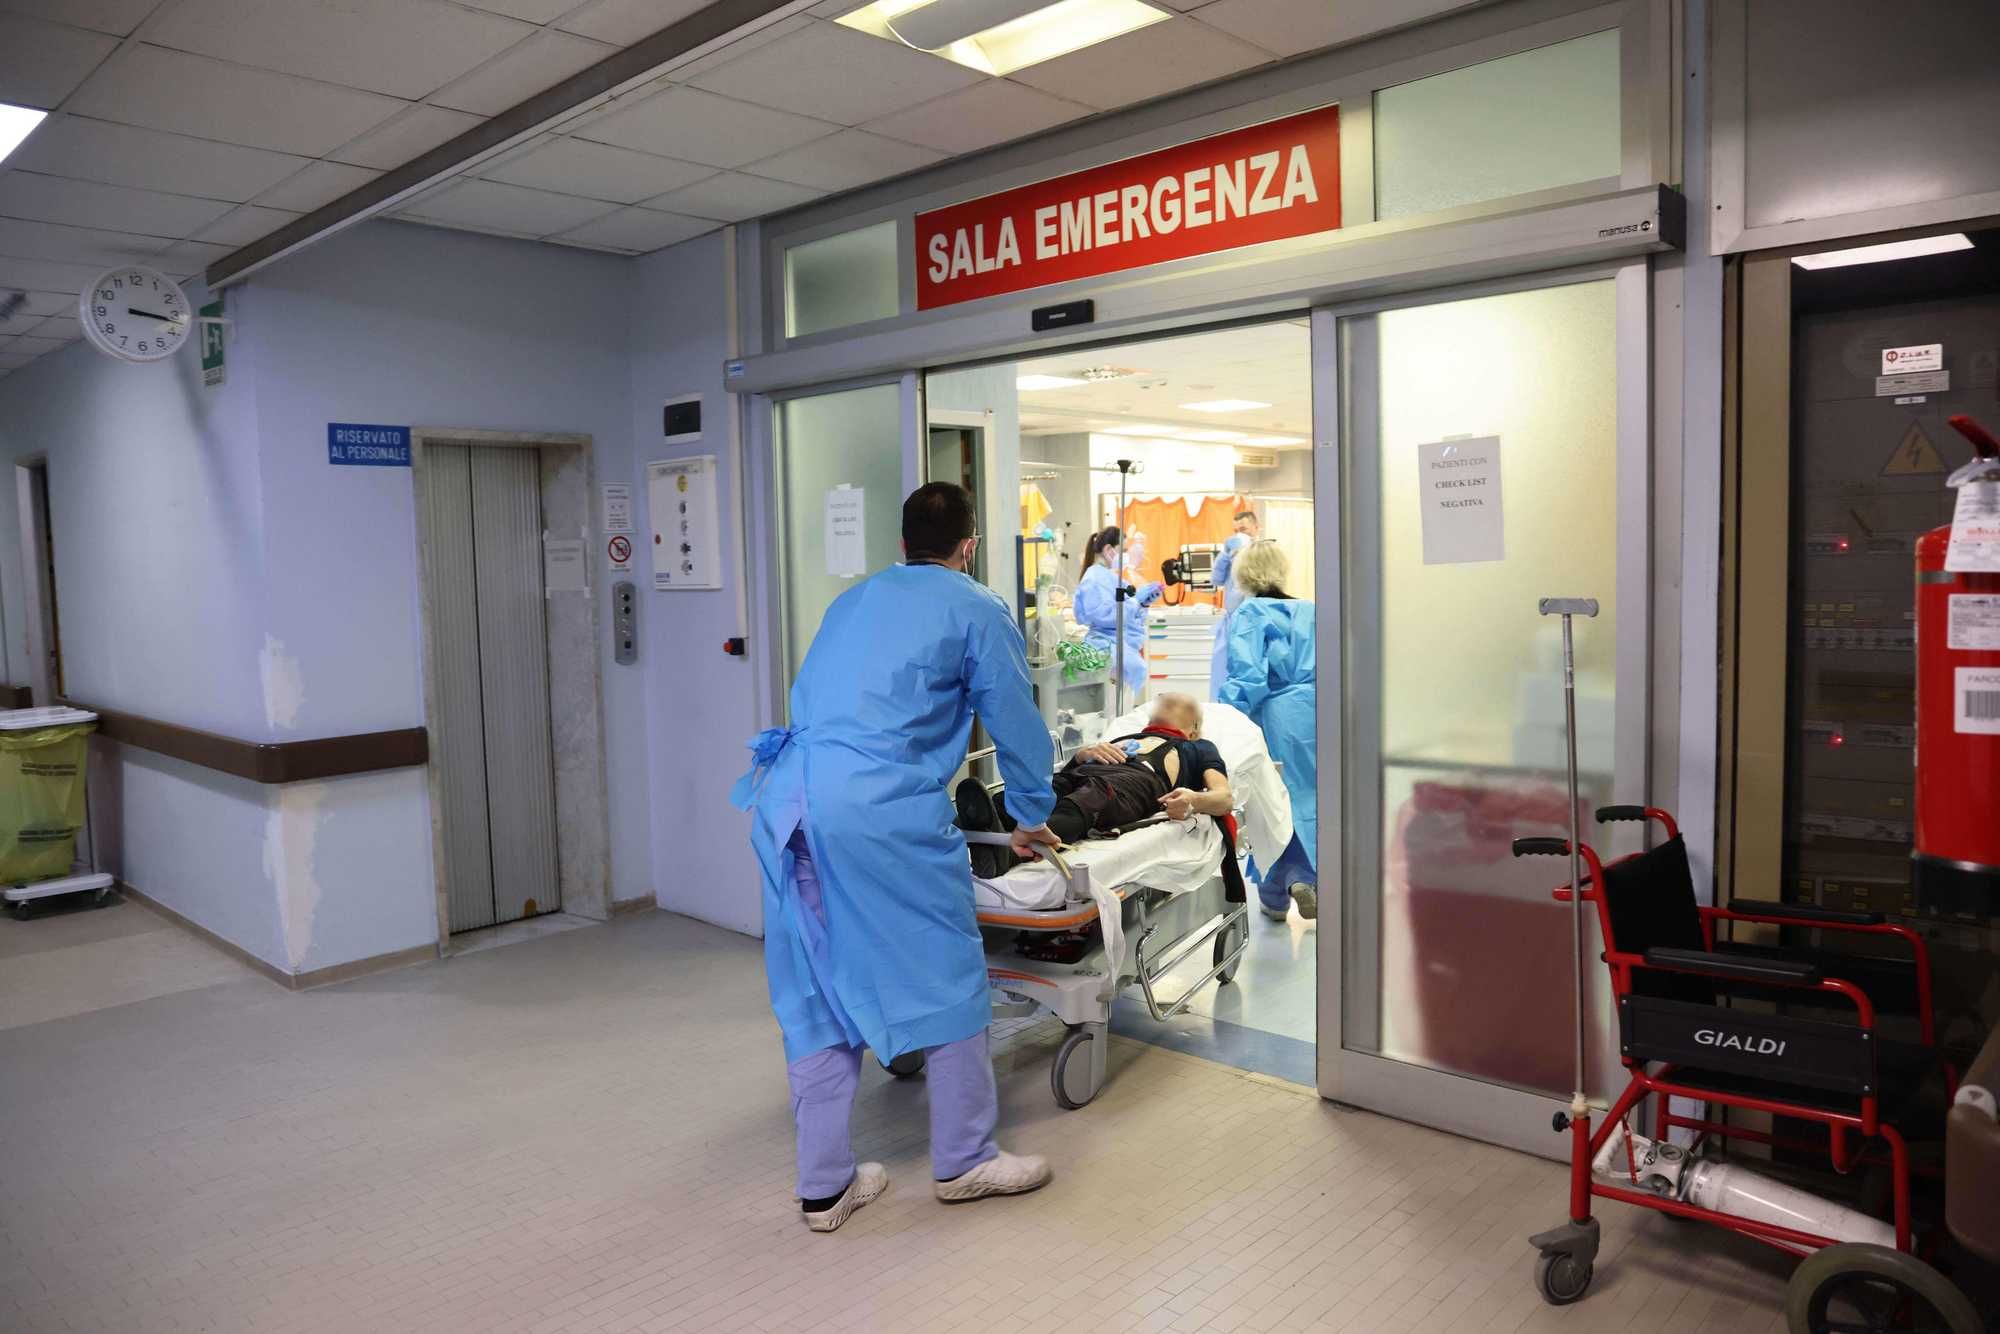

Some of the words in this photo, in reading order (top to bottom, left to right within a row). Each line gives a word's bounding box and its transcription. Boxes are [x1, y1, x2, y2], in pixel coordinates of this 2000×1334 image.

[928, 216, 1021, 283] SALA
[1035, 144, 1319, 261] EMERGENZA
[1599, 225, 1638, 237] manusa
[113, 279, 123, 288] 11
[129, 275, 143, 286] 12
[153, 281, 158, 291] 1
[101, 290, 114, 301] 10
[163, 294, 173, 304] 2
[97, 306, 106, 317] 9
[170, 310, 179, 320] 3
[105, 323, 115, 334] 8
[120, 335, 129, 346] 7
[155, 337, 165, 348] 5
[138, 341, 148, 352] 6
[336, 430, 401, 445] RISERVATO
[331, 445, 345, 459] AL
[347, 446, 408, 461] PERSONALE
[1469, 457, 1488, 466] CON
[1435, 480, 1466, 488] CHECK
[1467, 478, 1488, 487] LIST
[1440, 499, 1483, 508] NEGATIVA
[1694, 1029, 1786, 1056] GIALDI
